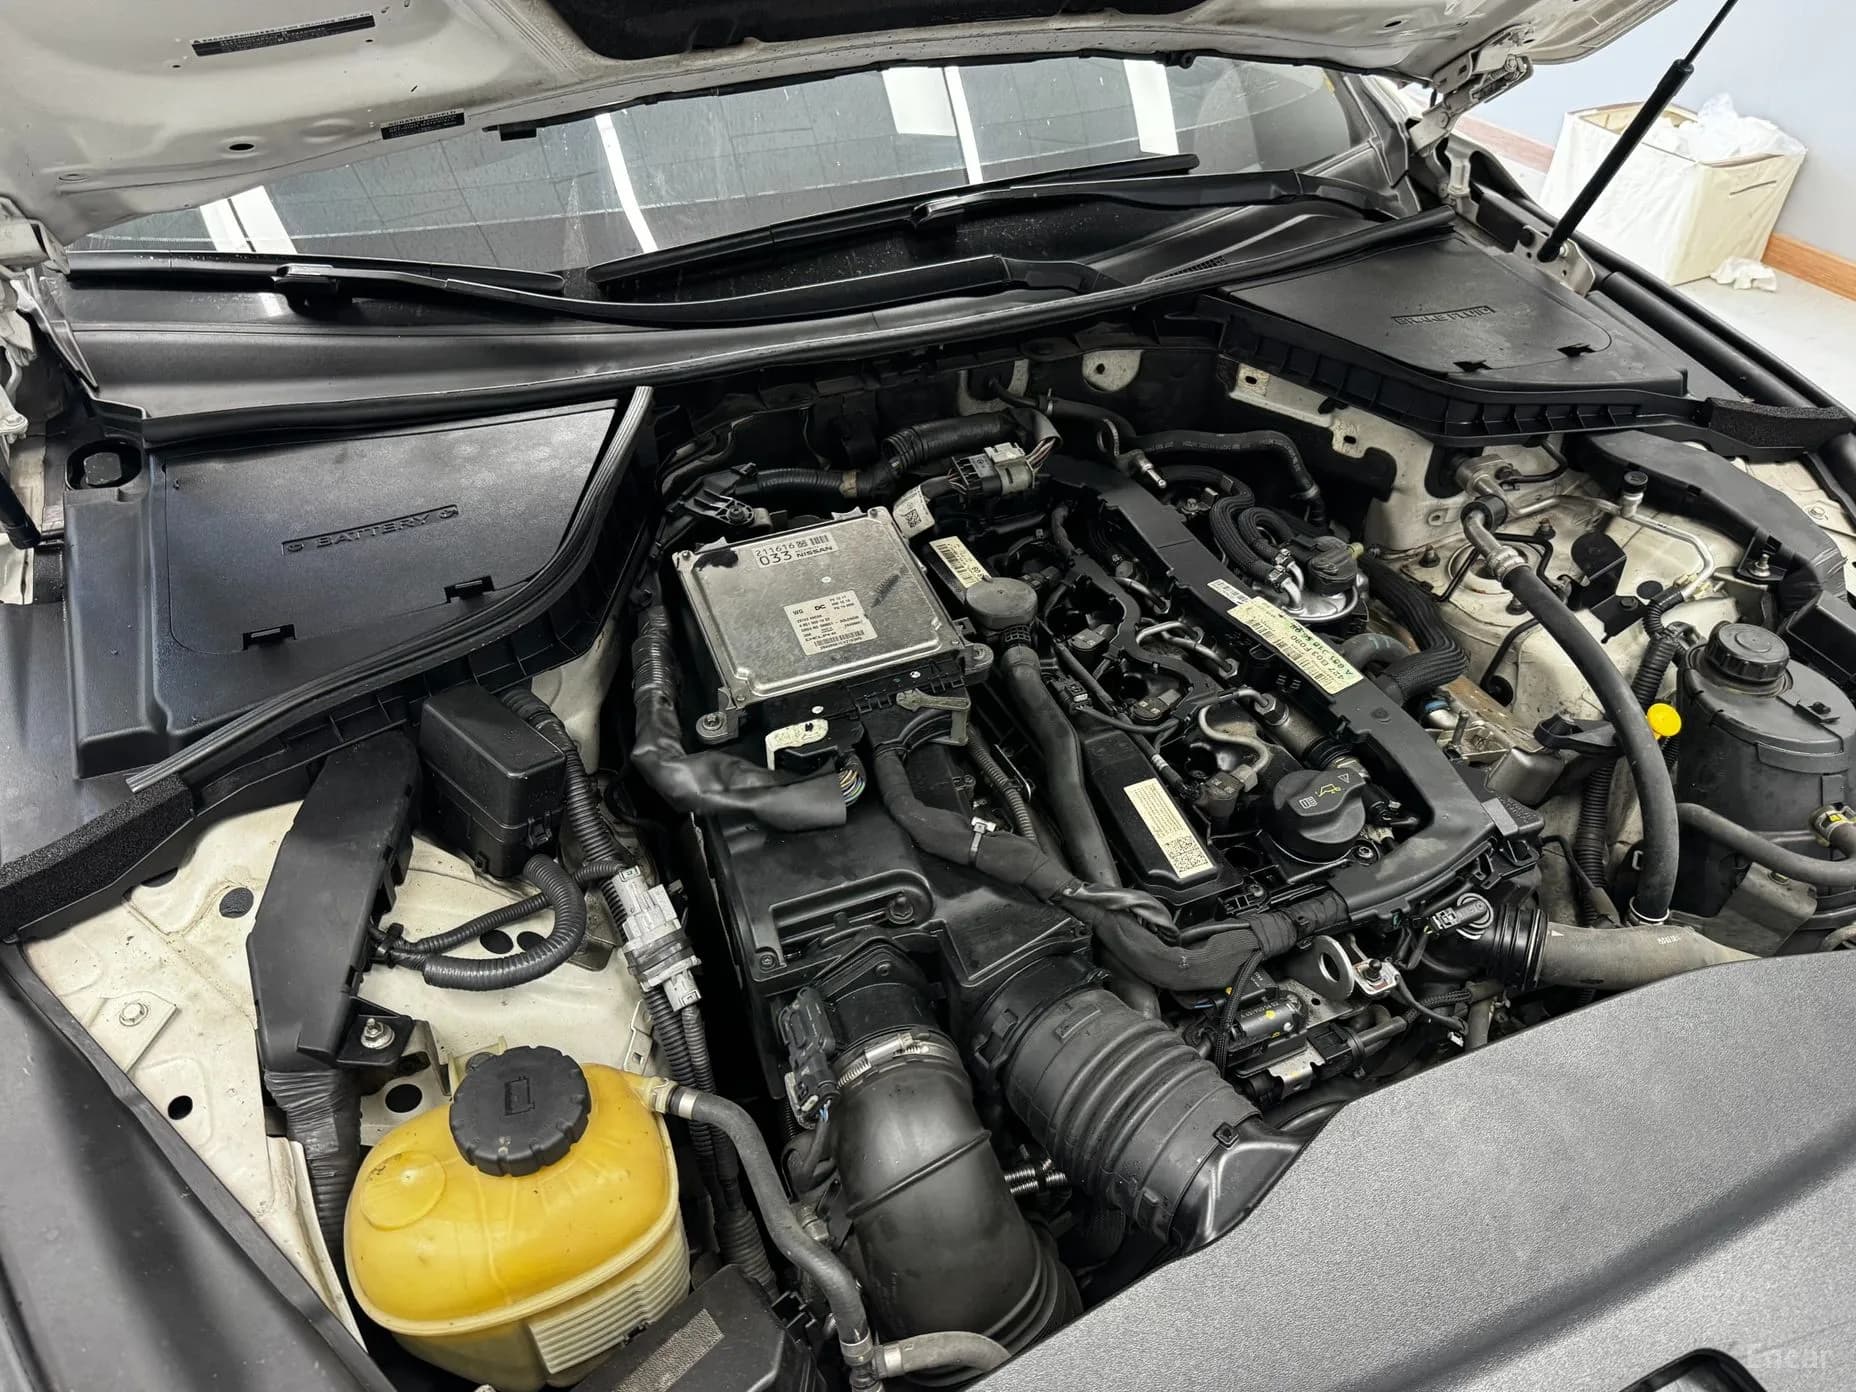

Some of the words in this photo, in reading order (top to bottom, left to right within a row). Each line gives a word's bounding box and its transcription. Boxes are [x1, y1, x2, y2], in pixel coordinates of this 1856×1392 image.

[316, 513, 430, 549] BATTERY
[759, 550, 792, 566] 033
[796, 546, 833, 558] NISSAN
